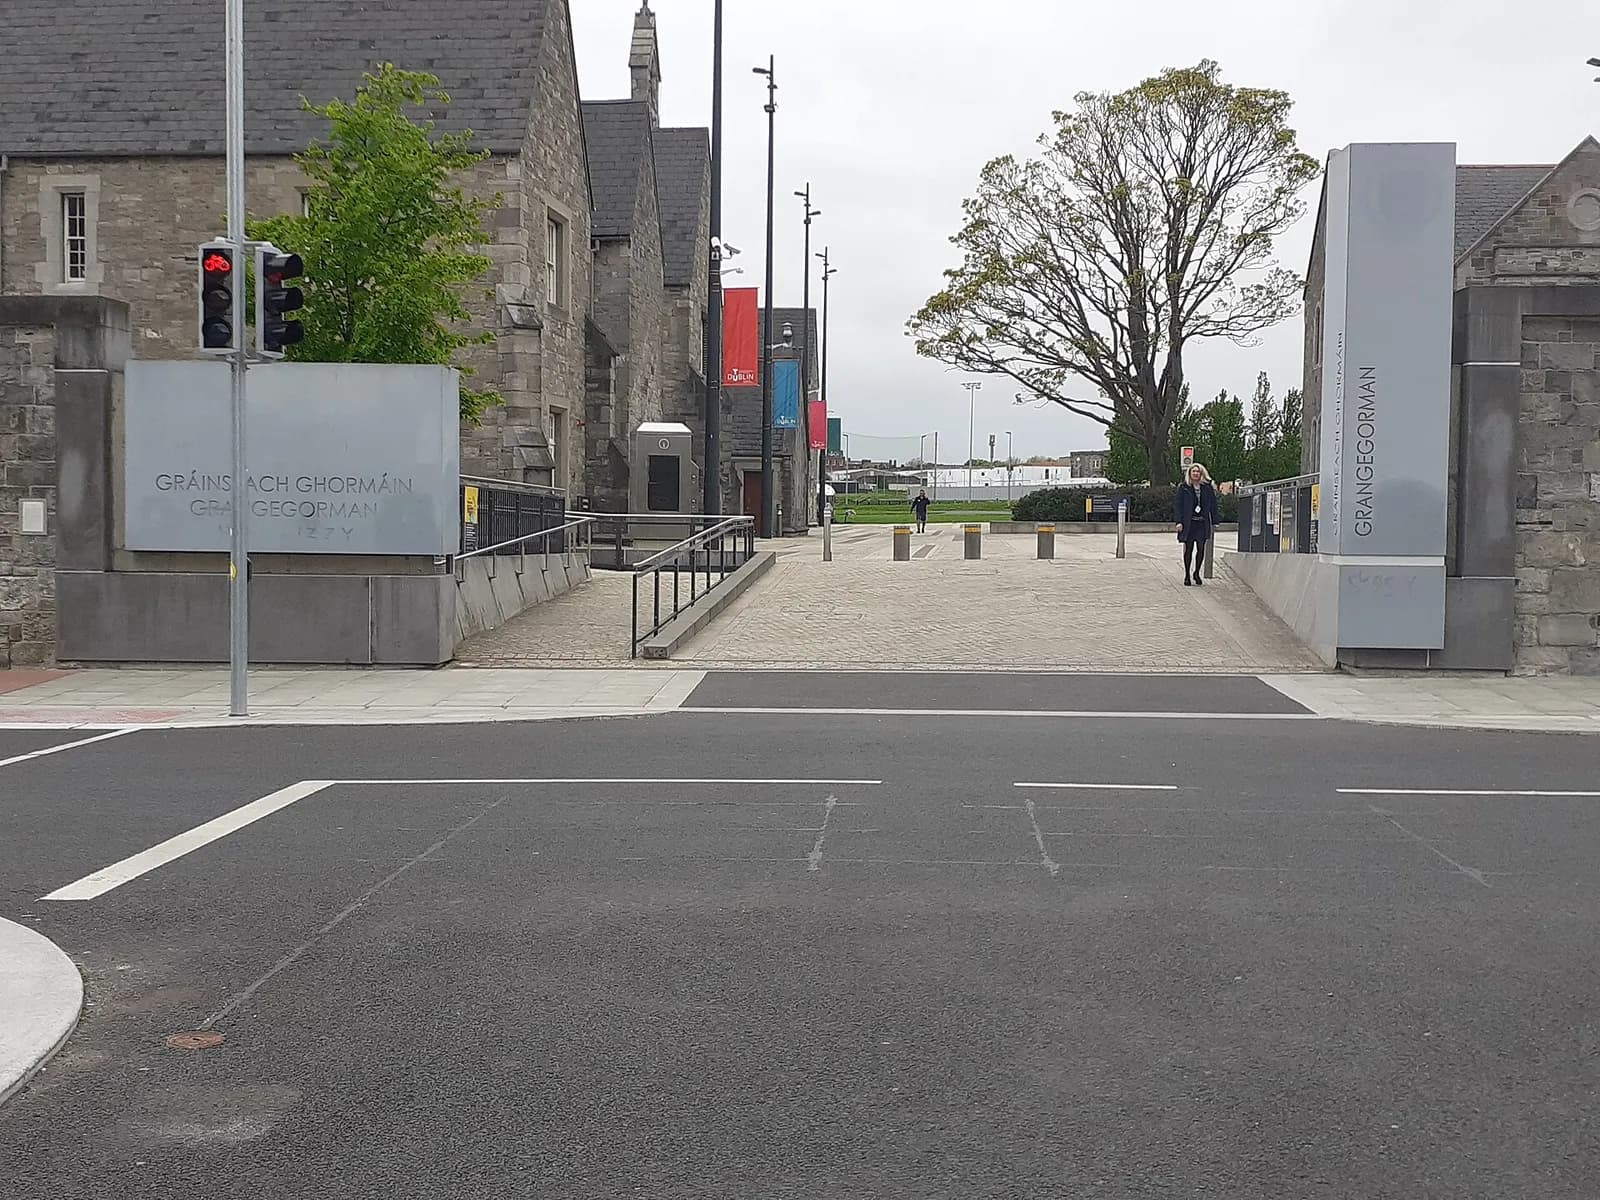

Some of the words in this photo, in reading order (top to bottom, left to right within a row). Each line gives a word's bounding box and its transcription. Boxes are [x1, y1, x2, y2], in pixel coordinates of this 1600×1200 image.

[1354, 367, 1376, 537] GRANGEGORMAN
[155, 470, 289, 492] GRÁINSACH
[296, 472, 412, 495] GHORMÁIN
[190, 499, 377, 518] GRAGEGORMAN
